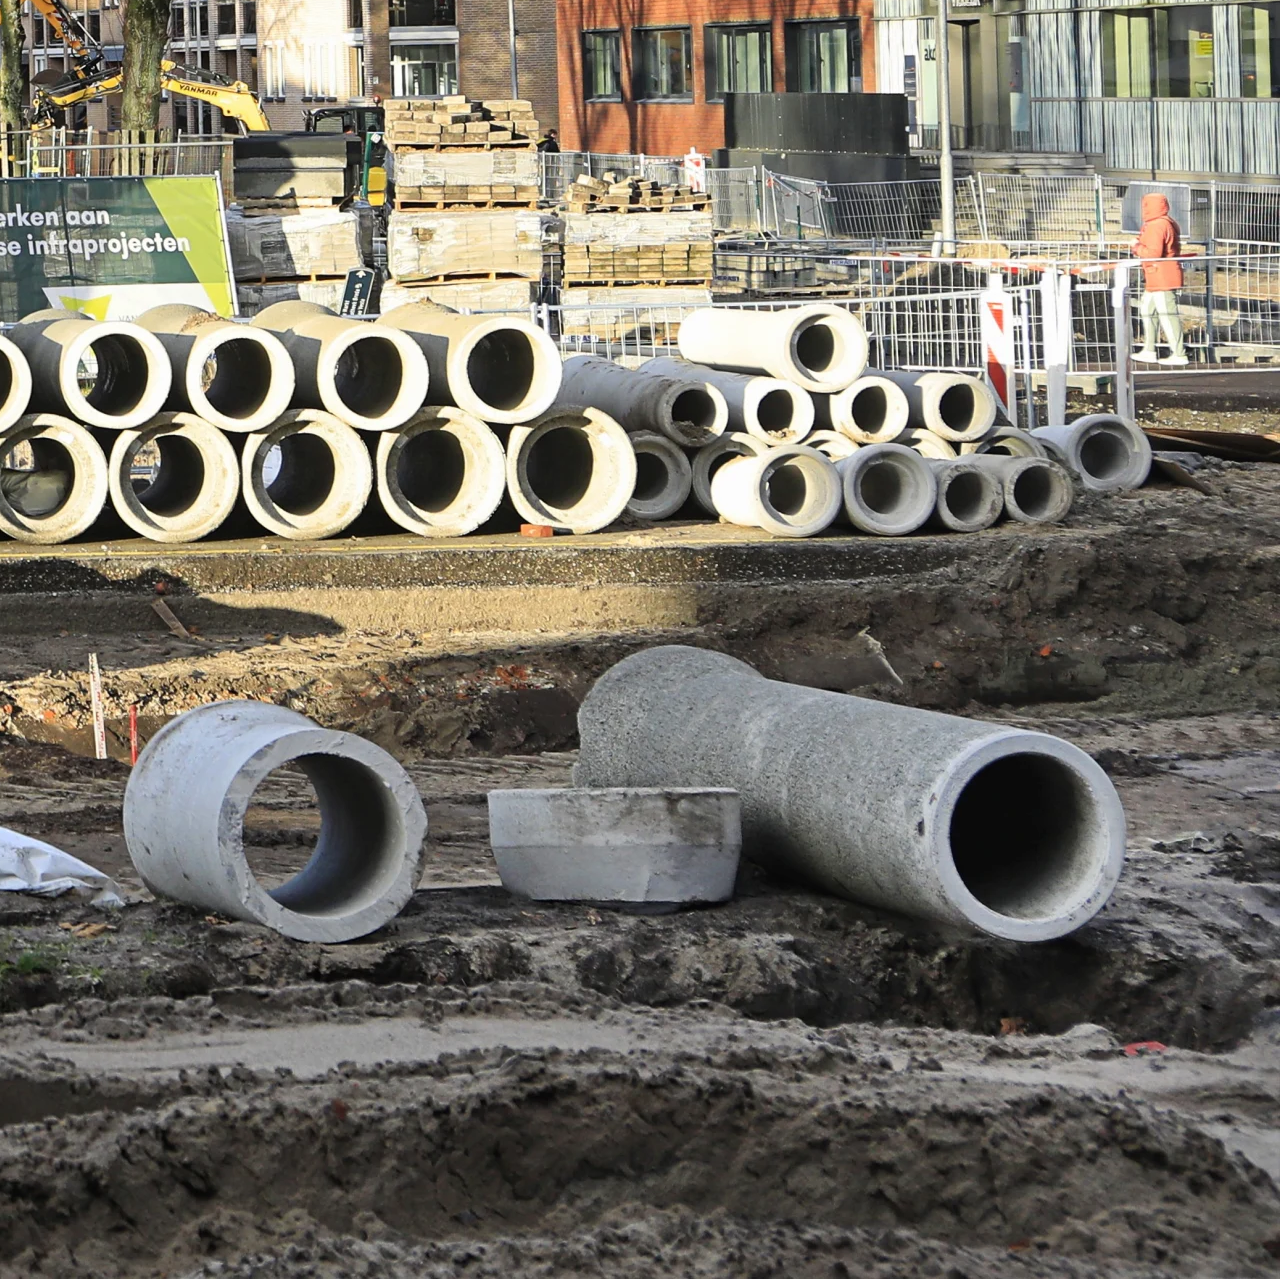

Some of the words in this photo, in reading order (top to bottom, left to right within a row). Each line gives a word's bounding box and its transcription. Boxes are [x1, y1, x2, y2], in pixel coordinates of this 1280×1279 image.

[179, 84, 218, 97] YANMAR
[66, 208, 110, 225] aan
[27, 233, 191, 261] infraprojecten
